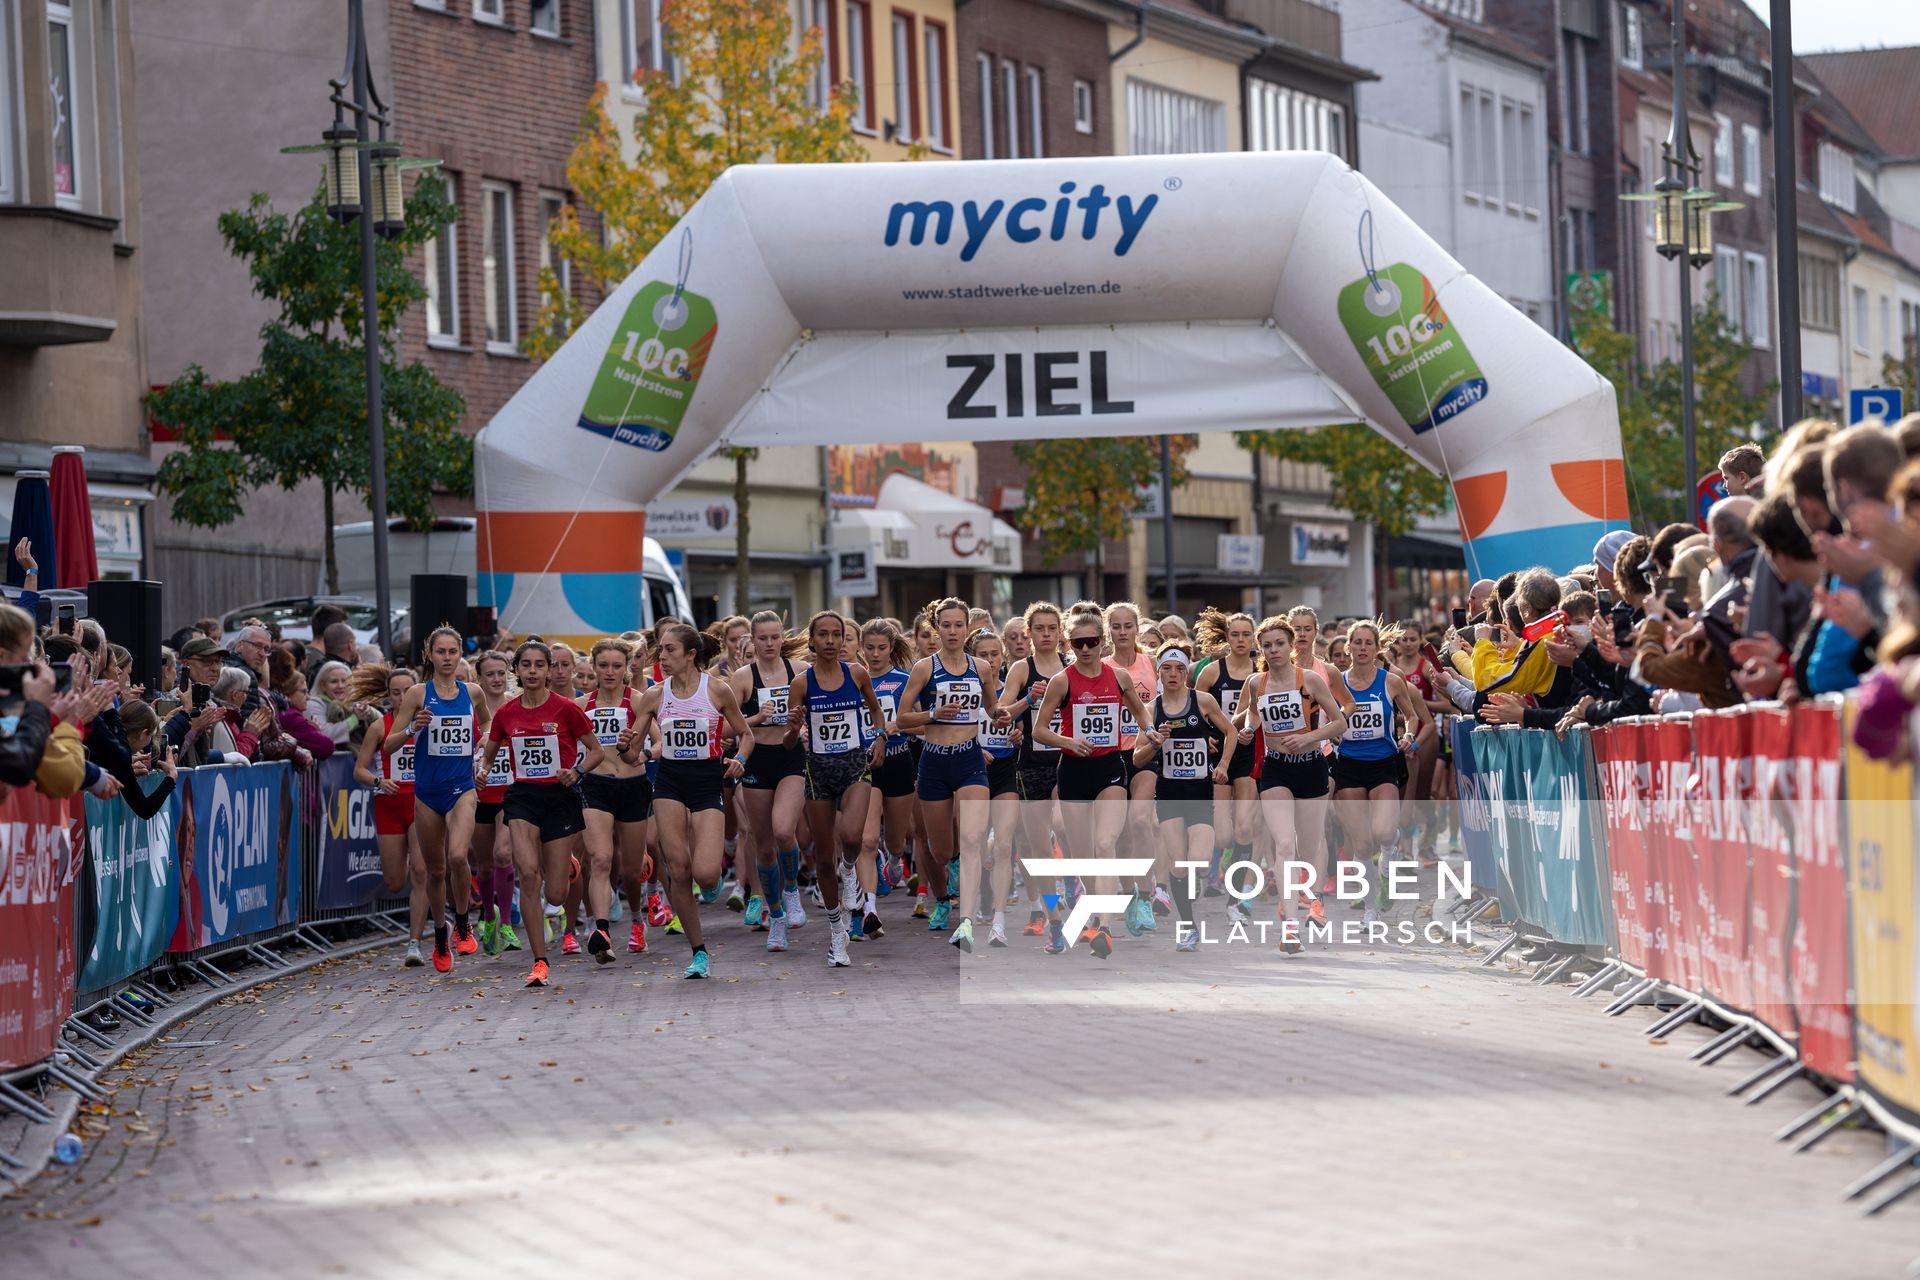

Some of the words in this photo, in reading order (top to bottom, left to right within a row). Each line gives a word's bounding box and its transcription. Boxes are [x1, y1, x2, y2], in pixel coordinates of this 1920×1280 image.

[884, 181, 1159, 262] mycity
[902, 280, 1121, 301] www.stadtwerke-uelzen.de
[1387, 338, 1453, 383] Naturstrom
[613, 366, 684, 400] Naturstrom
[946, 350, 1135, 420] ZIEL
[1438, 384, 1483, 418] mycity
[617, 427, 666, 450] mycity
[939, 694, 980, 710] 1029
[1260, 702, 1301, 722] 1063
[819, 723, 851, 740] 972
[1081, 717, 1113, 734] 995
[430, 728, 471, 744] 1033
[664, 731, 708, 747] 1080
[886, 743, 909, 757] NIKE
[924, 742, 949, 755] NIKE
[951, 740, 973, 755] PRO
[1268, 749, 1280, 760] RO
[1284, 750, 1314, 763] NIKE
[397, 756, 415, 770] 96
[521, 749, 553, 766] 258
[1165, 751, 1206, 767] 1030
[492, 759, 510, 774] 56
[234, 787, 268, 869] PLAN
[348, 851, 359, 871] We
